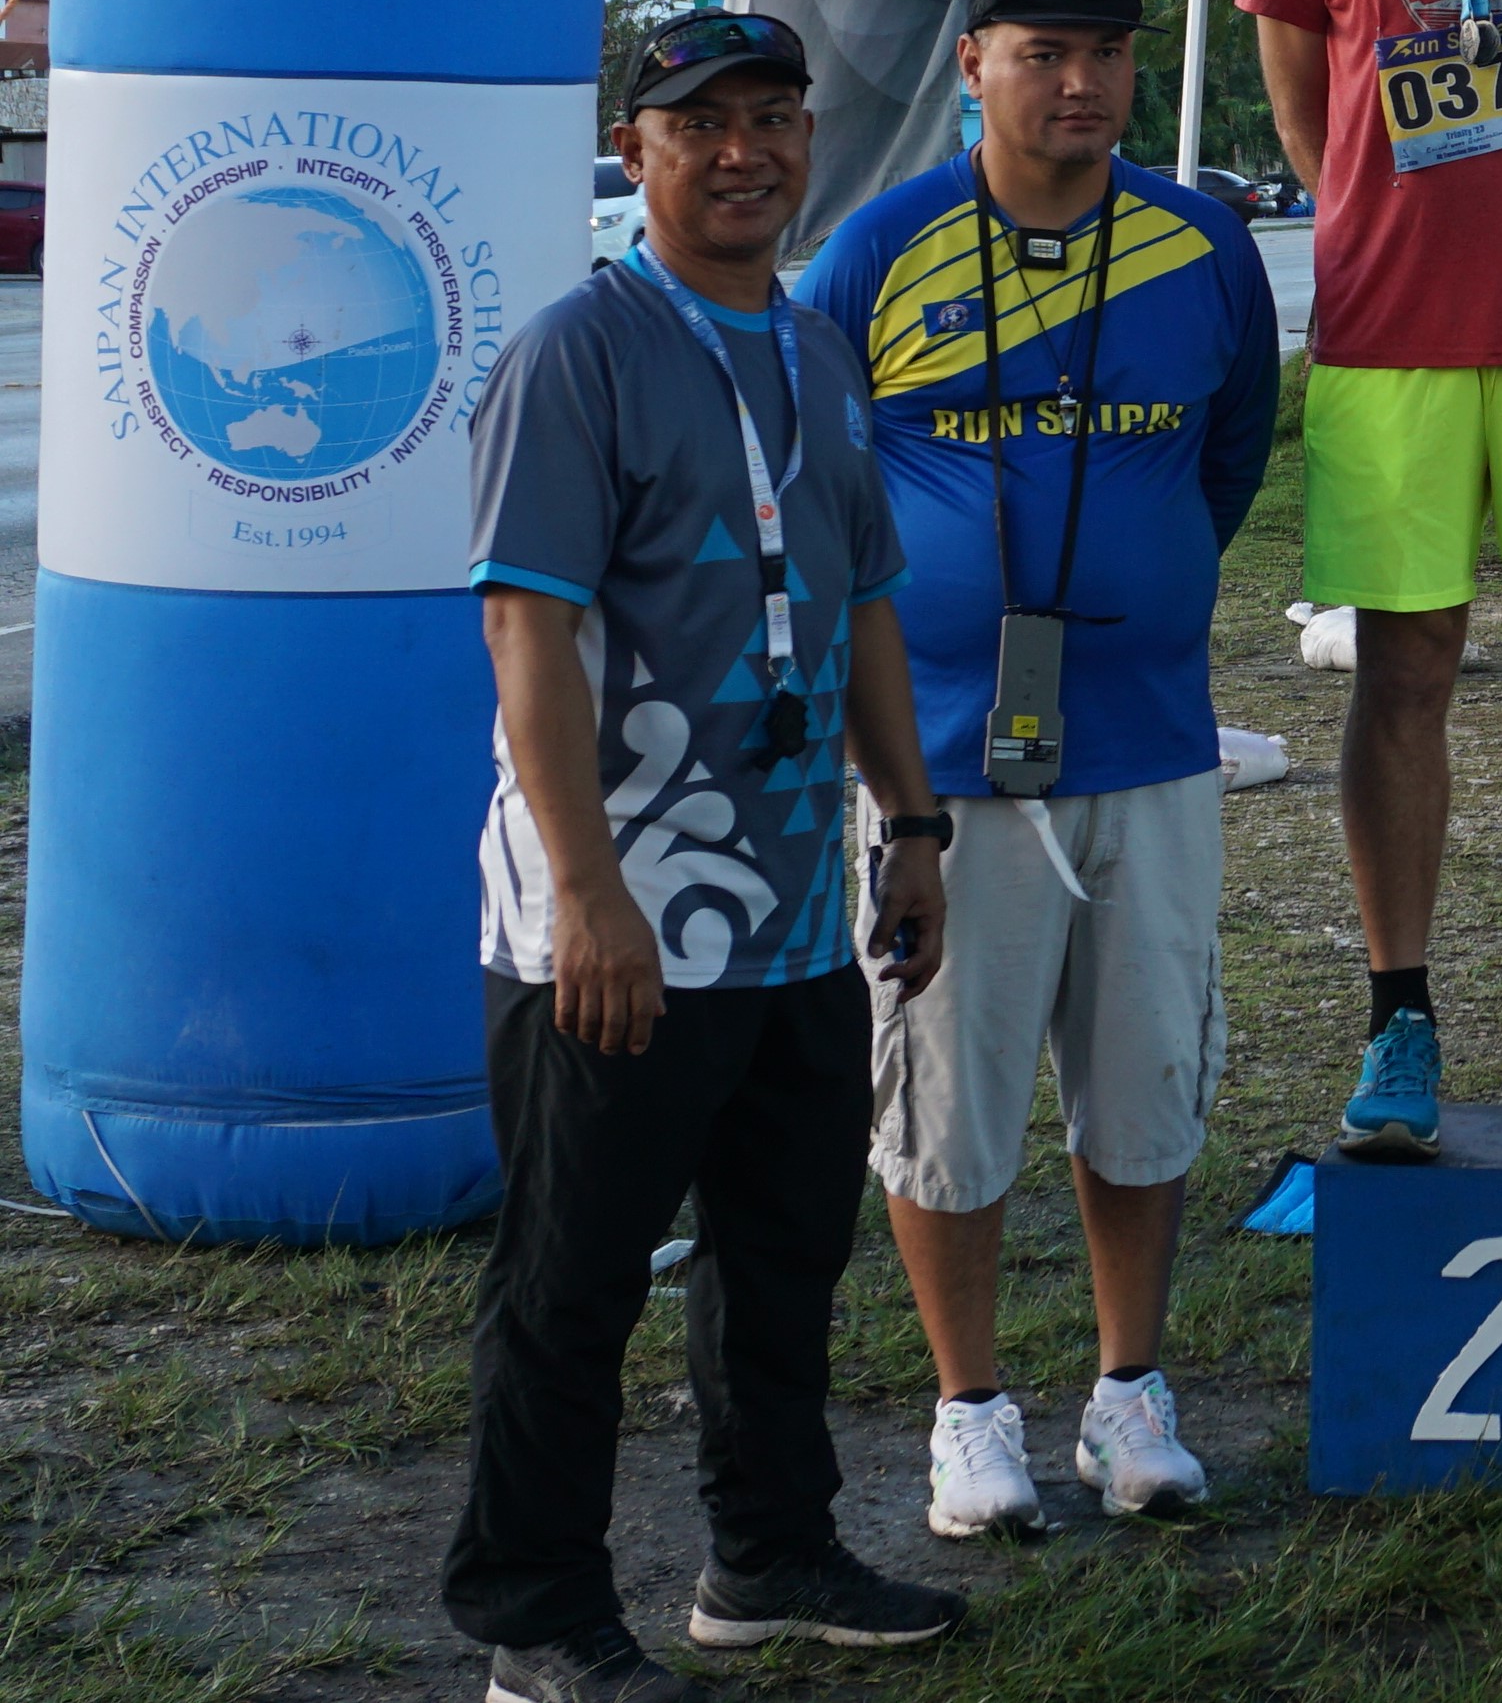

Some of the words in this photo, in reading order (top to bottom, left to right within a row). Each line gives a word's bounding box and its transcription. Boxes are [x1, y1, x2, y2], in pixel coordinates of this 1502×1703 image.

[114, 111, 464, 244] INTERNATIONAL
[164, 159, 269, 225] LEADERSHIP
[297, 158, 396, 201] INTEGRITY
[129, 236, 162, 359] COMPASSION
[408, 211, 462, 356] PERSEVERANCE
[97, 253, 140, 440] SAIPAN
[137, 380, 193, 461] RESPECT
[390, 378, 454, 464] INITIATIVE
[929, 402, 1023, 443] RUN
[207, 468, 371, 503] RESPONSIBILITY
